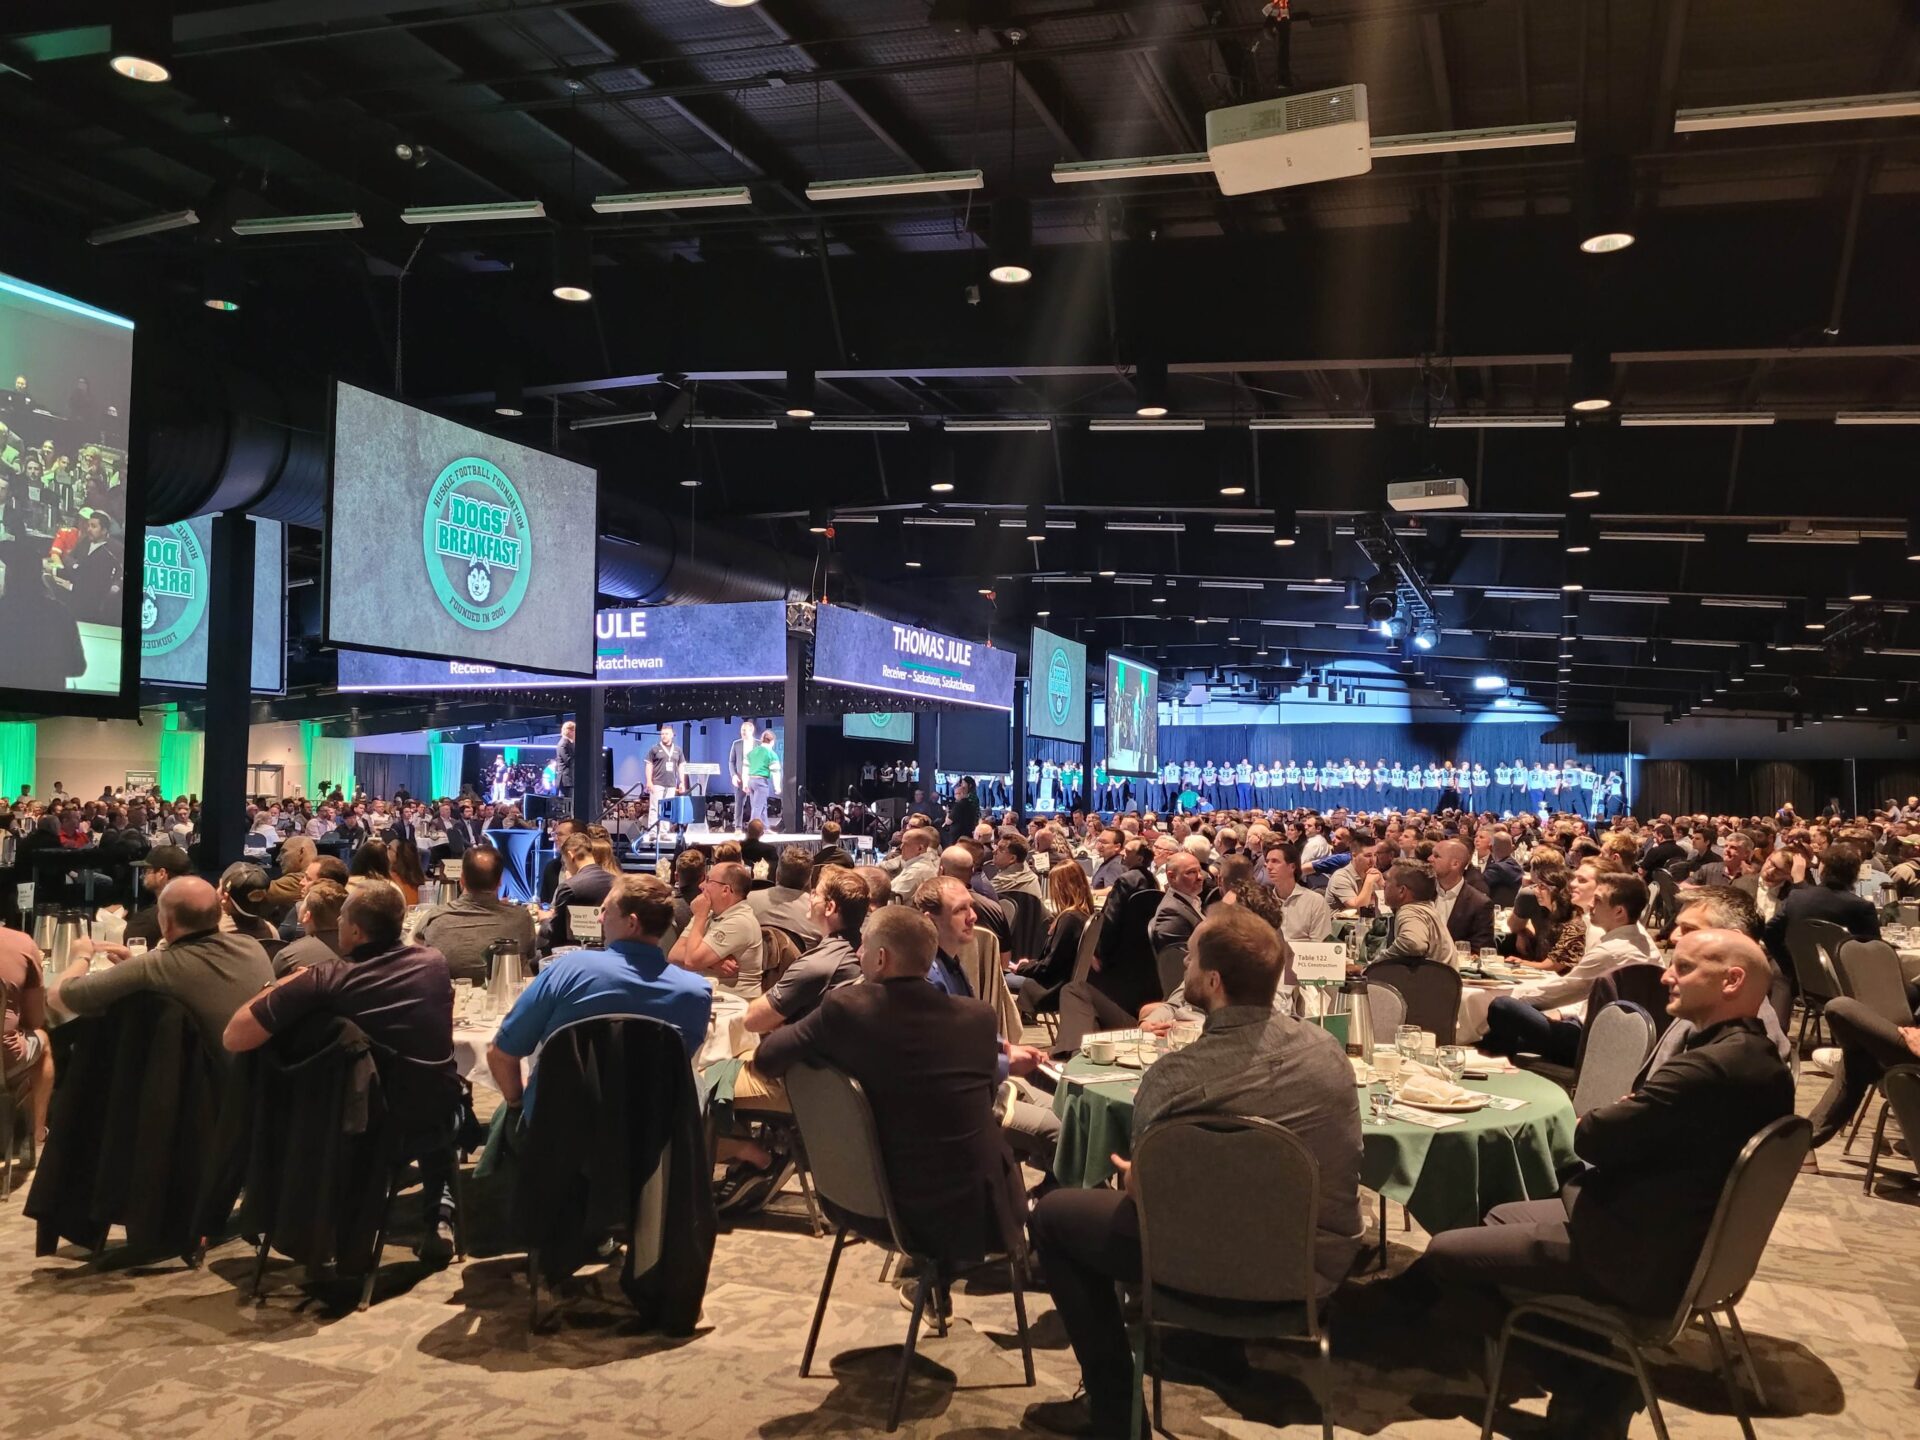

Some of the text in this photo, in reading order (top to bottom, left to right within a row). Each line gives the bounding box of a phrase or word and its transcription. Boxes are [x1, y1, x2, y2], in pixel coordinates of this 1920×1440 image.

[433, 464, 525, 530] HUSKIE FOOTBALL FOUNDATION
[452, 498, 507, 534] DOGS'
[439, 524, 518, 566] BREAKFAST
[449, 596, 506, 623] FOUNDED IN 2001
[596, 612, 647, 639] ULE
[596, 654, 663, 670] katchewan
[893, 626, 972, 666] THOMAS JULE
[882, 664, 907, 680] Receiver
[942, 676, 975, 692] Saskatchewan
